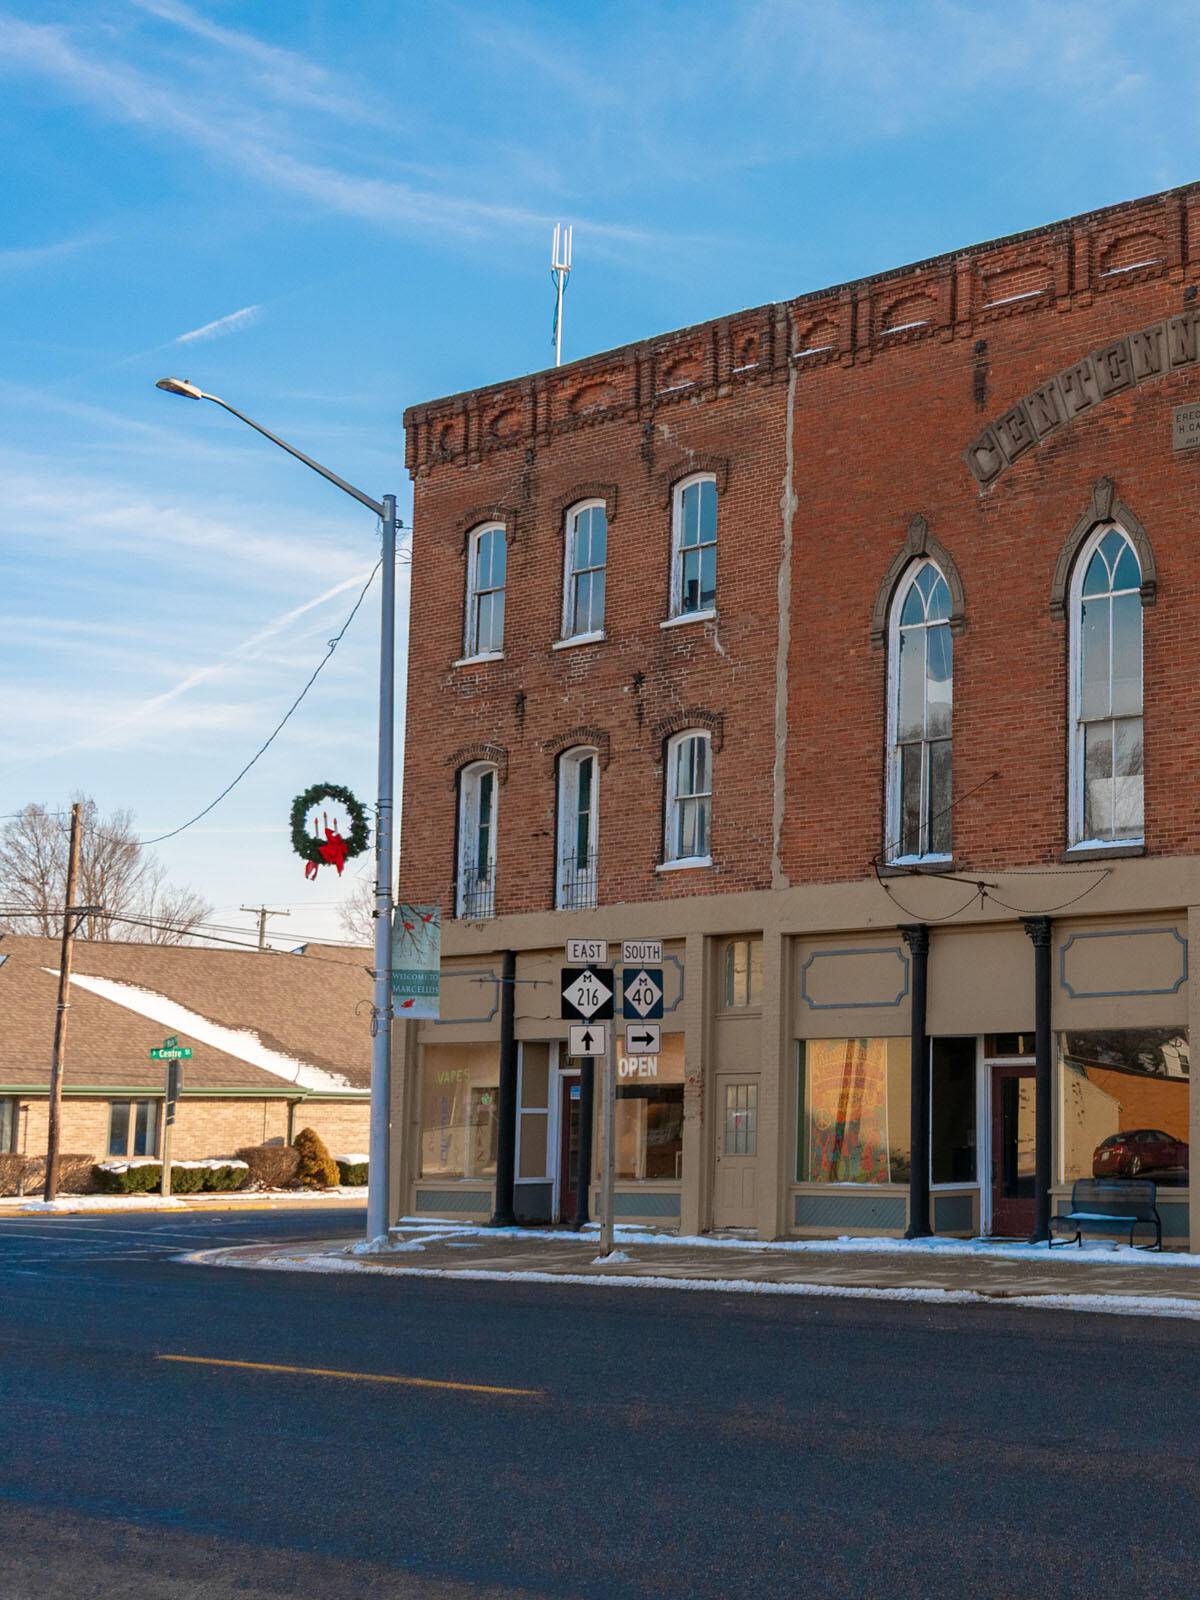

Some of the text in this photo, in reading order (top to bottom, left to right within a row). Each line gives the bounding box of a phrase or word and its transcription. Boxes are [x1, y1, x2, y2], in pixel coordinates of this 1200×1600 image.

[573, 944, 602, 958] EAST
[625, 945, 660, 959] SOUTH
[583, 974, 592, 983] M
[638, 978, 648, 986] M
[577, 988, 599, 1006] 216
[632, 987, 654, 1006] 40
[618, 1056, 658, 1077] OPEN
[437, 1068, 470, 1085] VAPES
